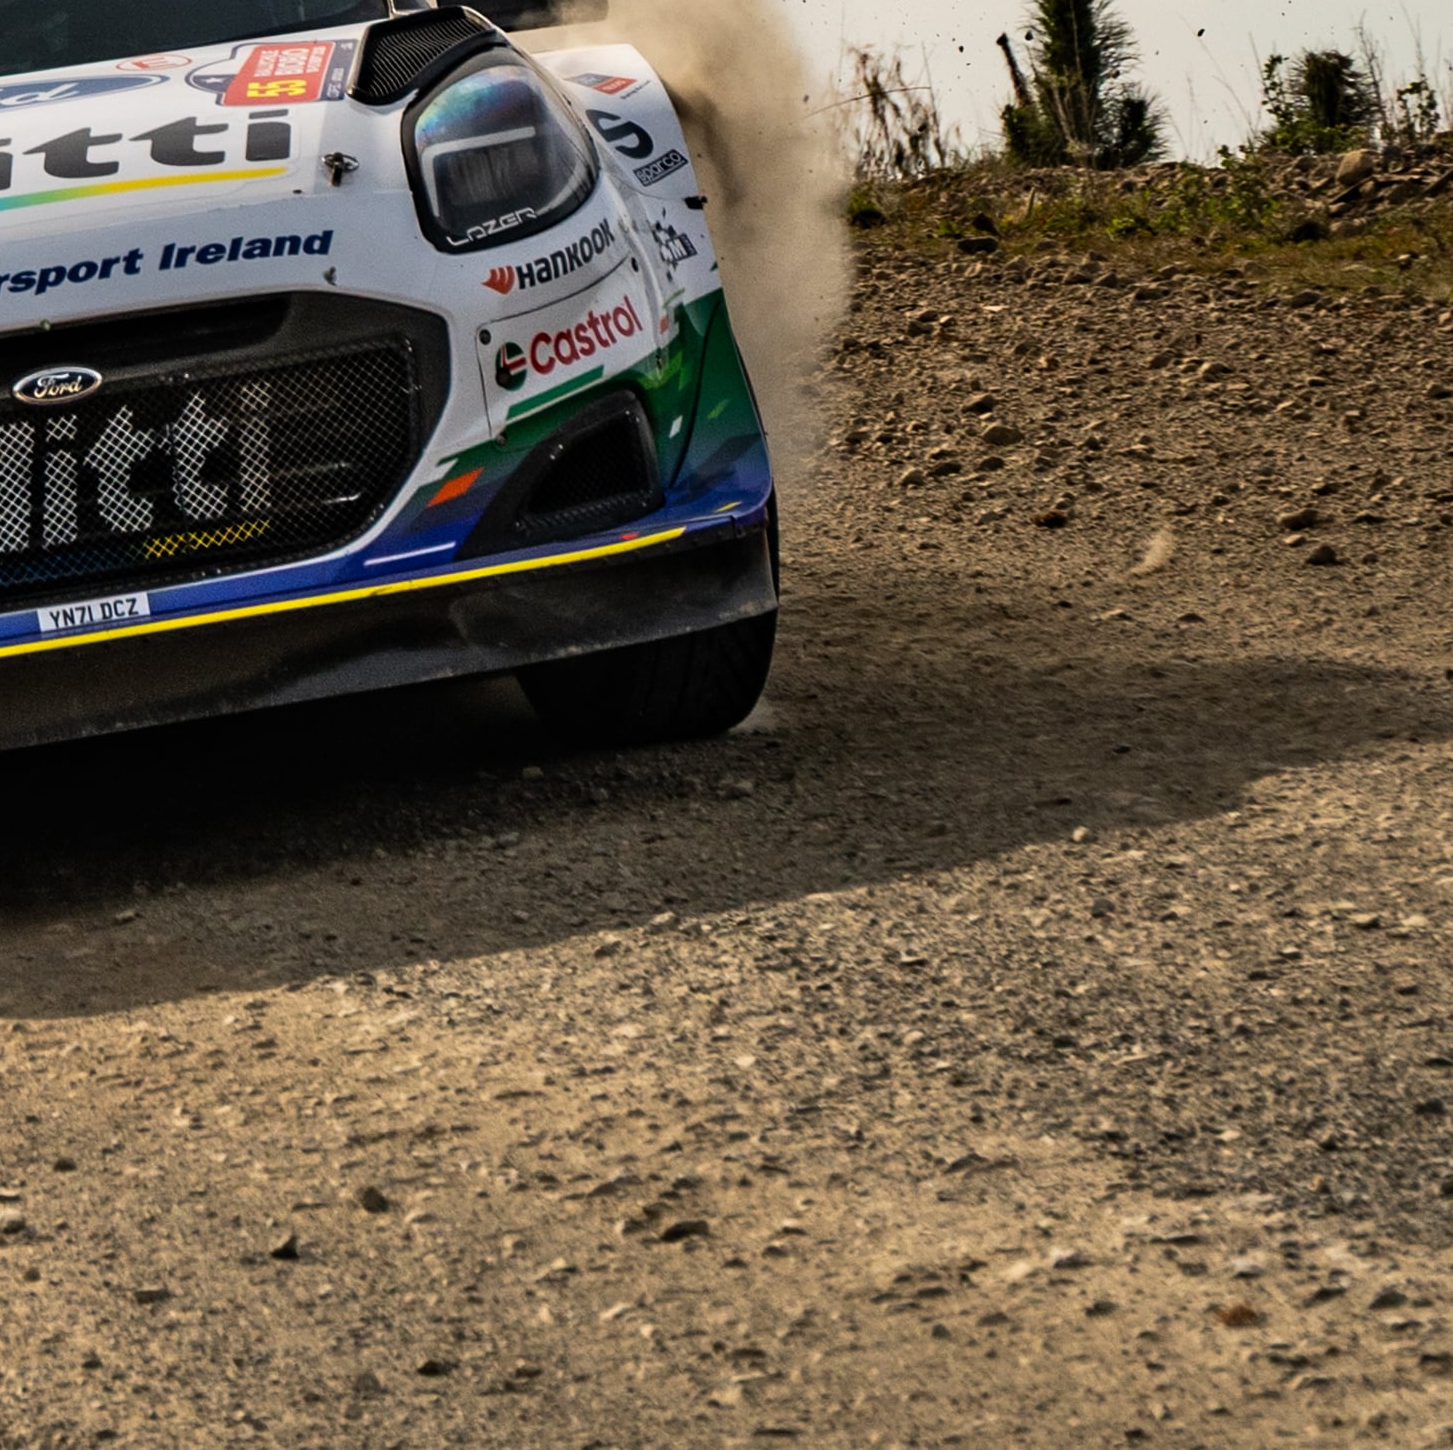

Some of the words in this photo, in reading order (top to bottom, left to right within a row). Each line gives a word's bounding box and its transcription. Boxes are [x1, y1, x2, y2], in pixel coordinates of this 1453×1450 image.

[158, 230, 334, 271] Ireland
[530, 294, 643, 375] Castrol
[33, 373, 82, 398] Ford
[100, 598, 139, 620] DCZ
